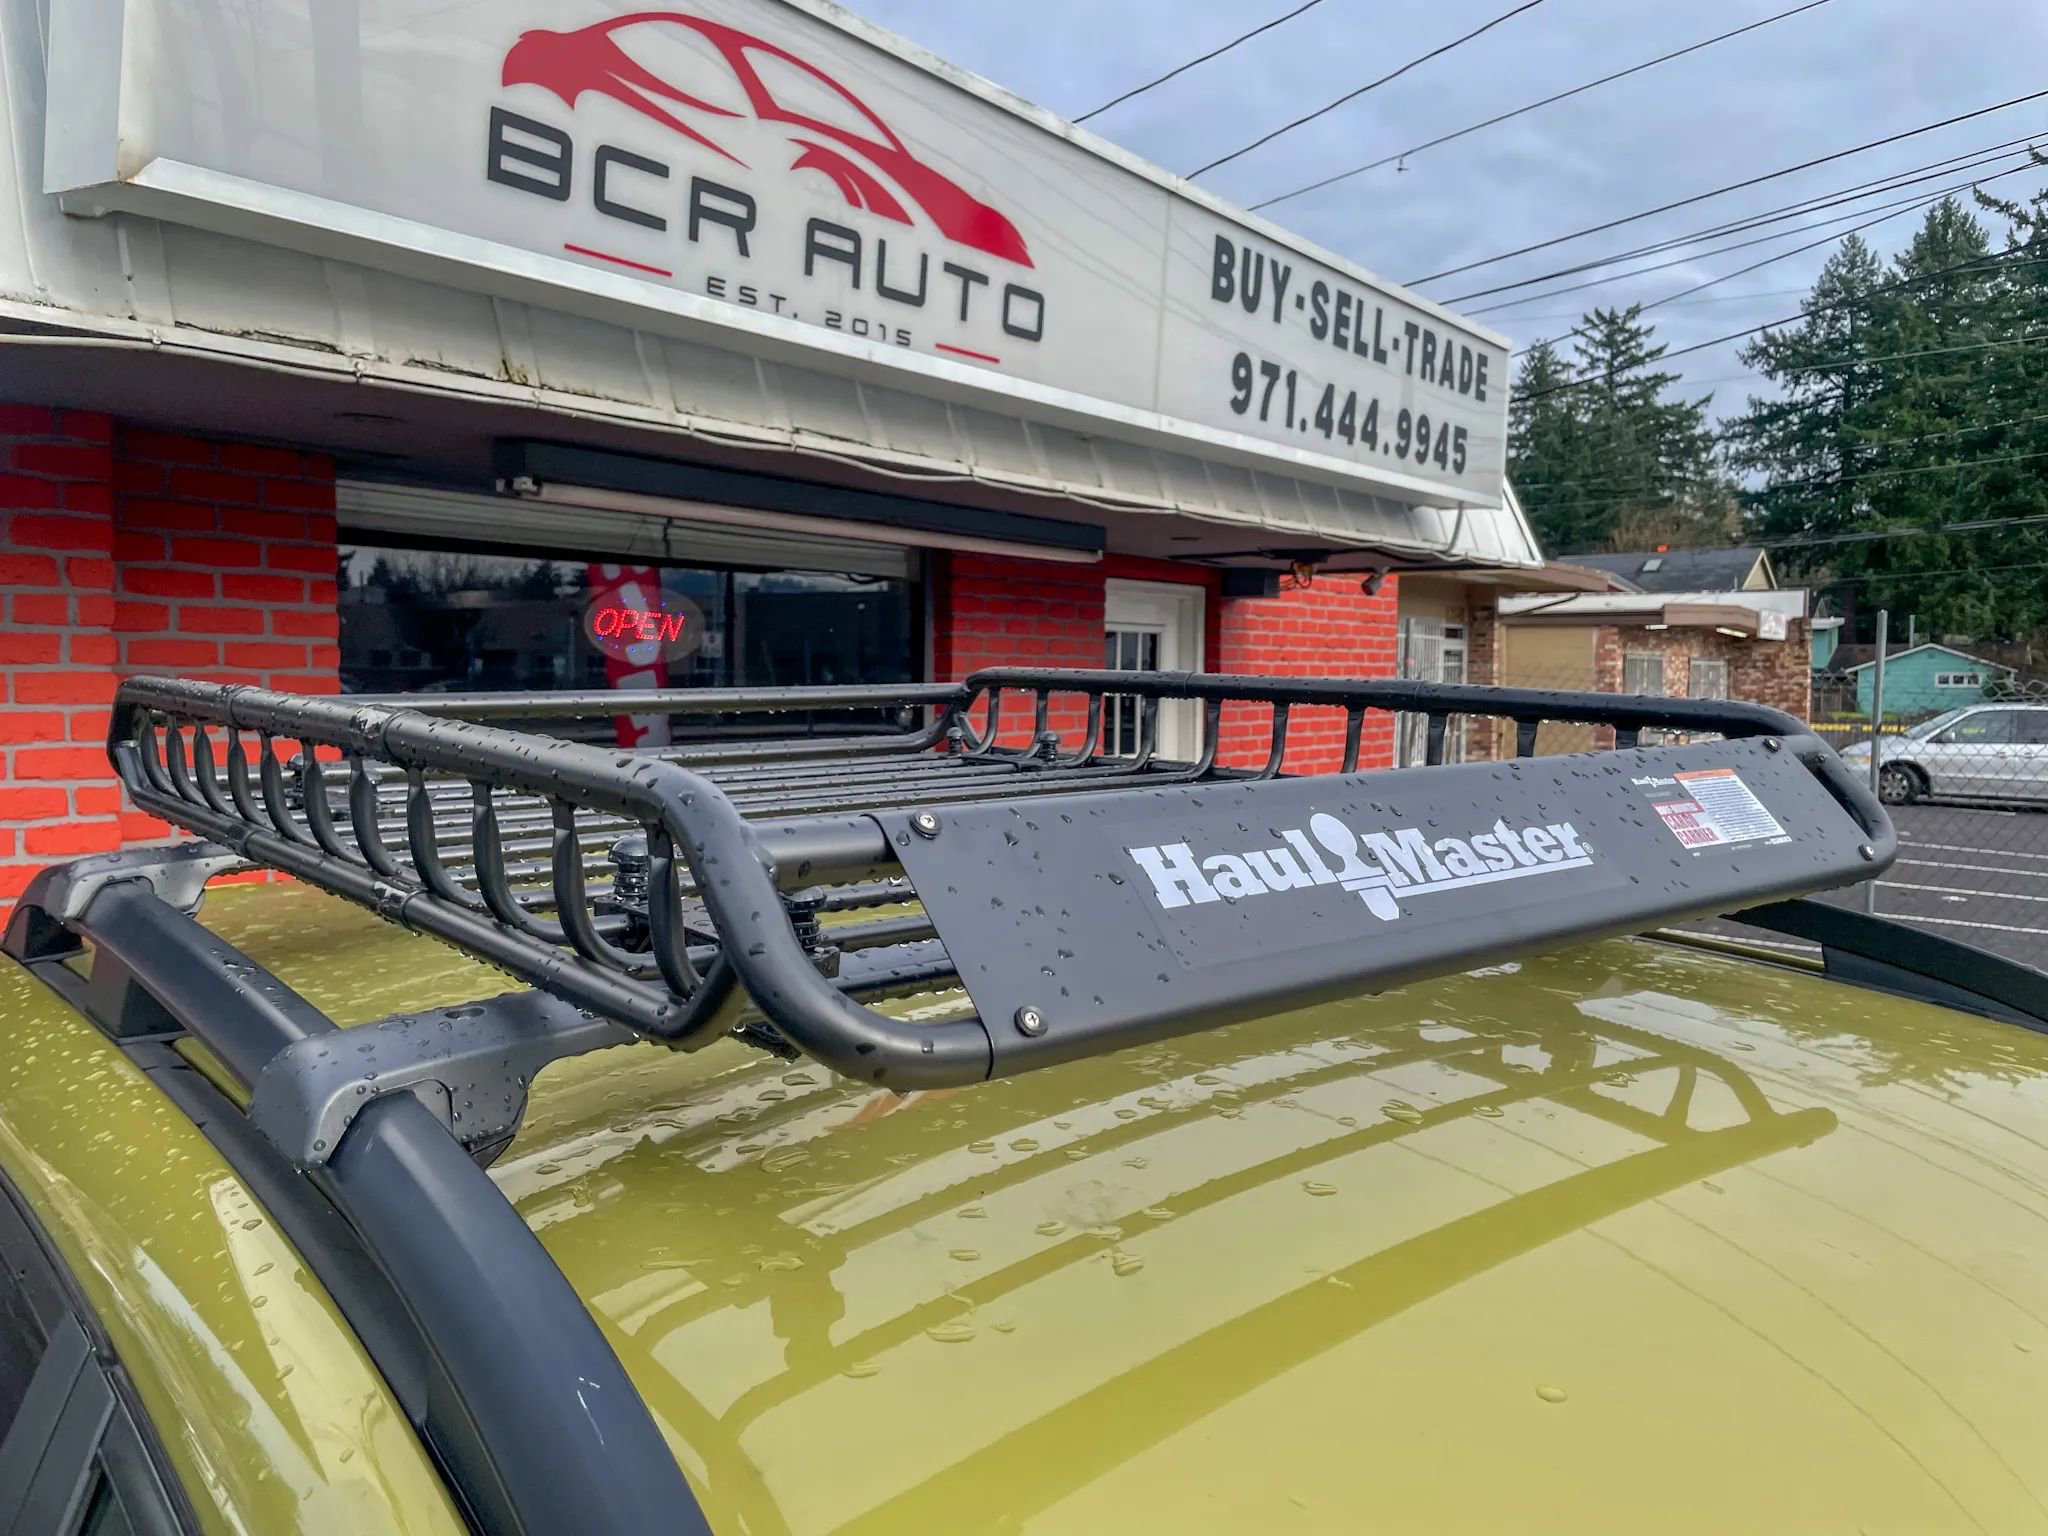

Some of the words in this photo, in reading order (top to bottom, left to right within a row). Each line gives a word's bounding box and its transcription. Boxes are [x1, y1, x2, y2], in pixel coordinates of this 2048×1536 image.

[487, 105, 757, 258] BCR
[803, 217, 1045, 343] AUTO
[706, 275, 799, 319] EST.
[825, 310, 912, 347] 2015
[1229, 351, 1468, 475] 971.444.9945
[592, 607, 685, 642] OPEN
[1129, 828, 1338, 910] Haul
